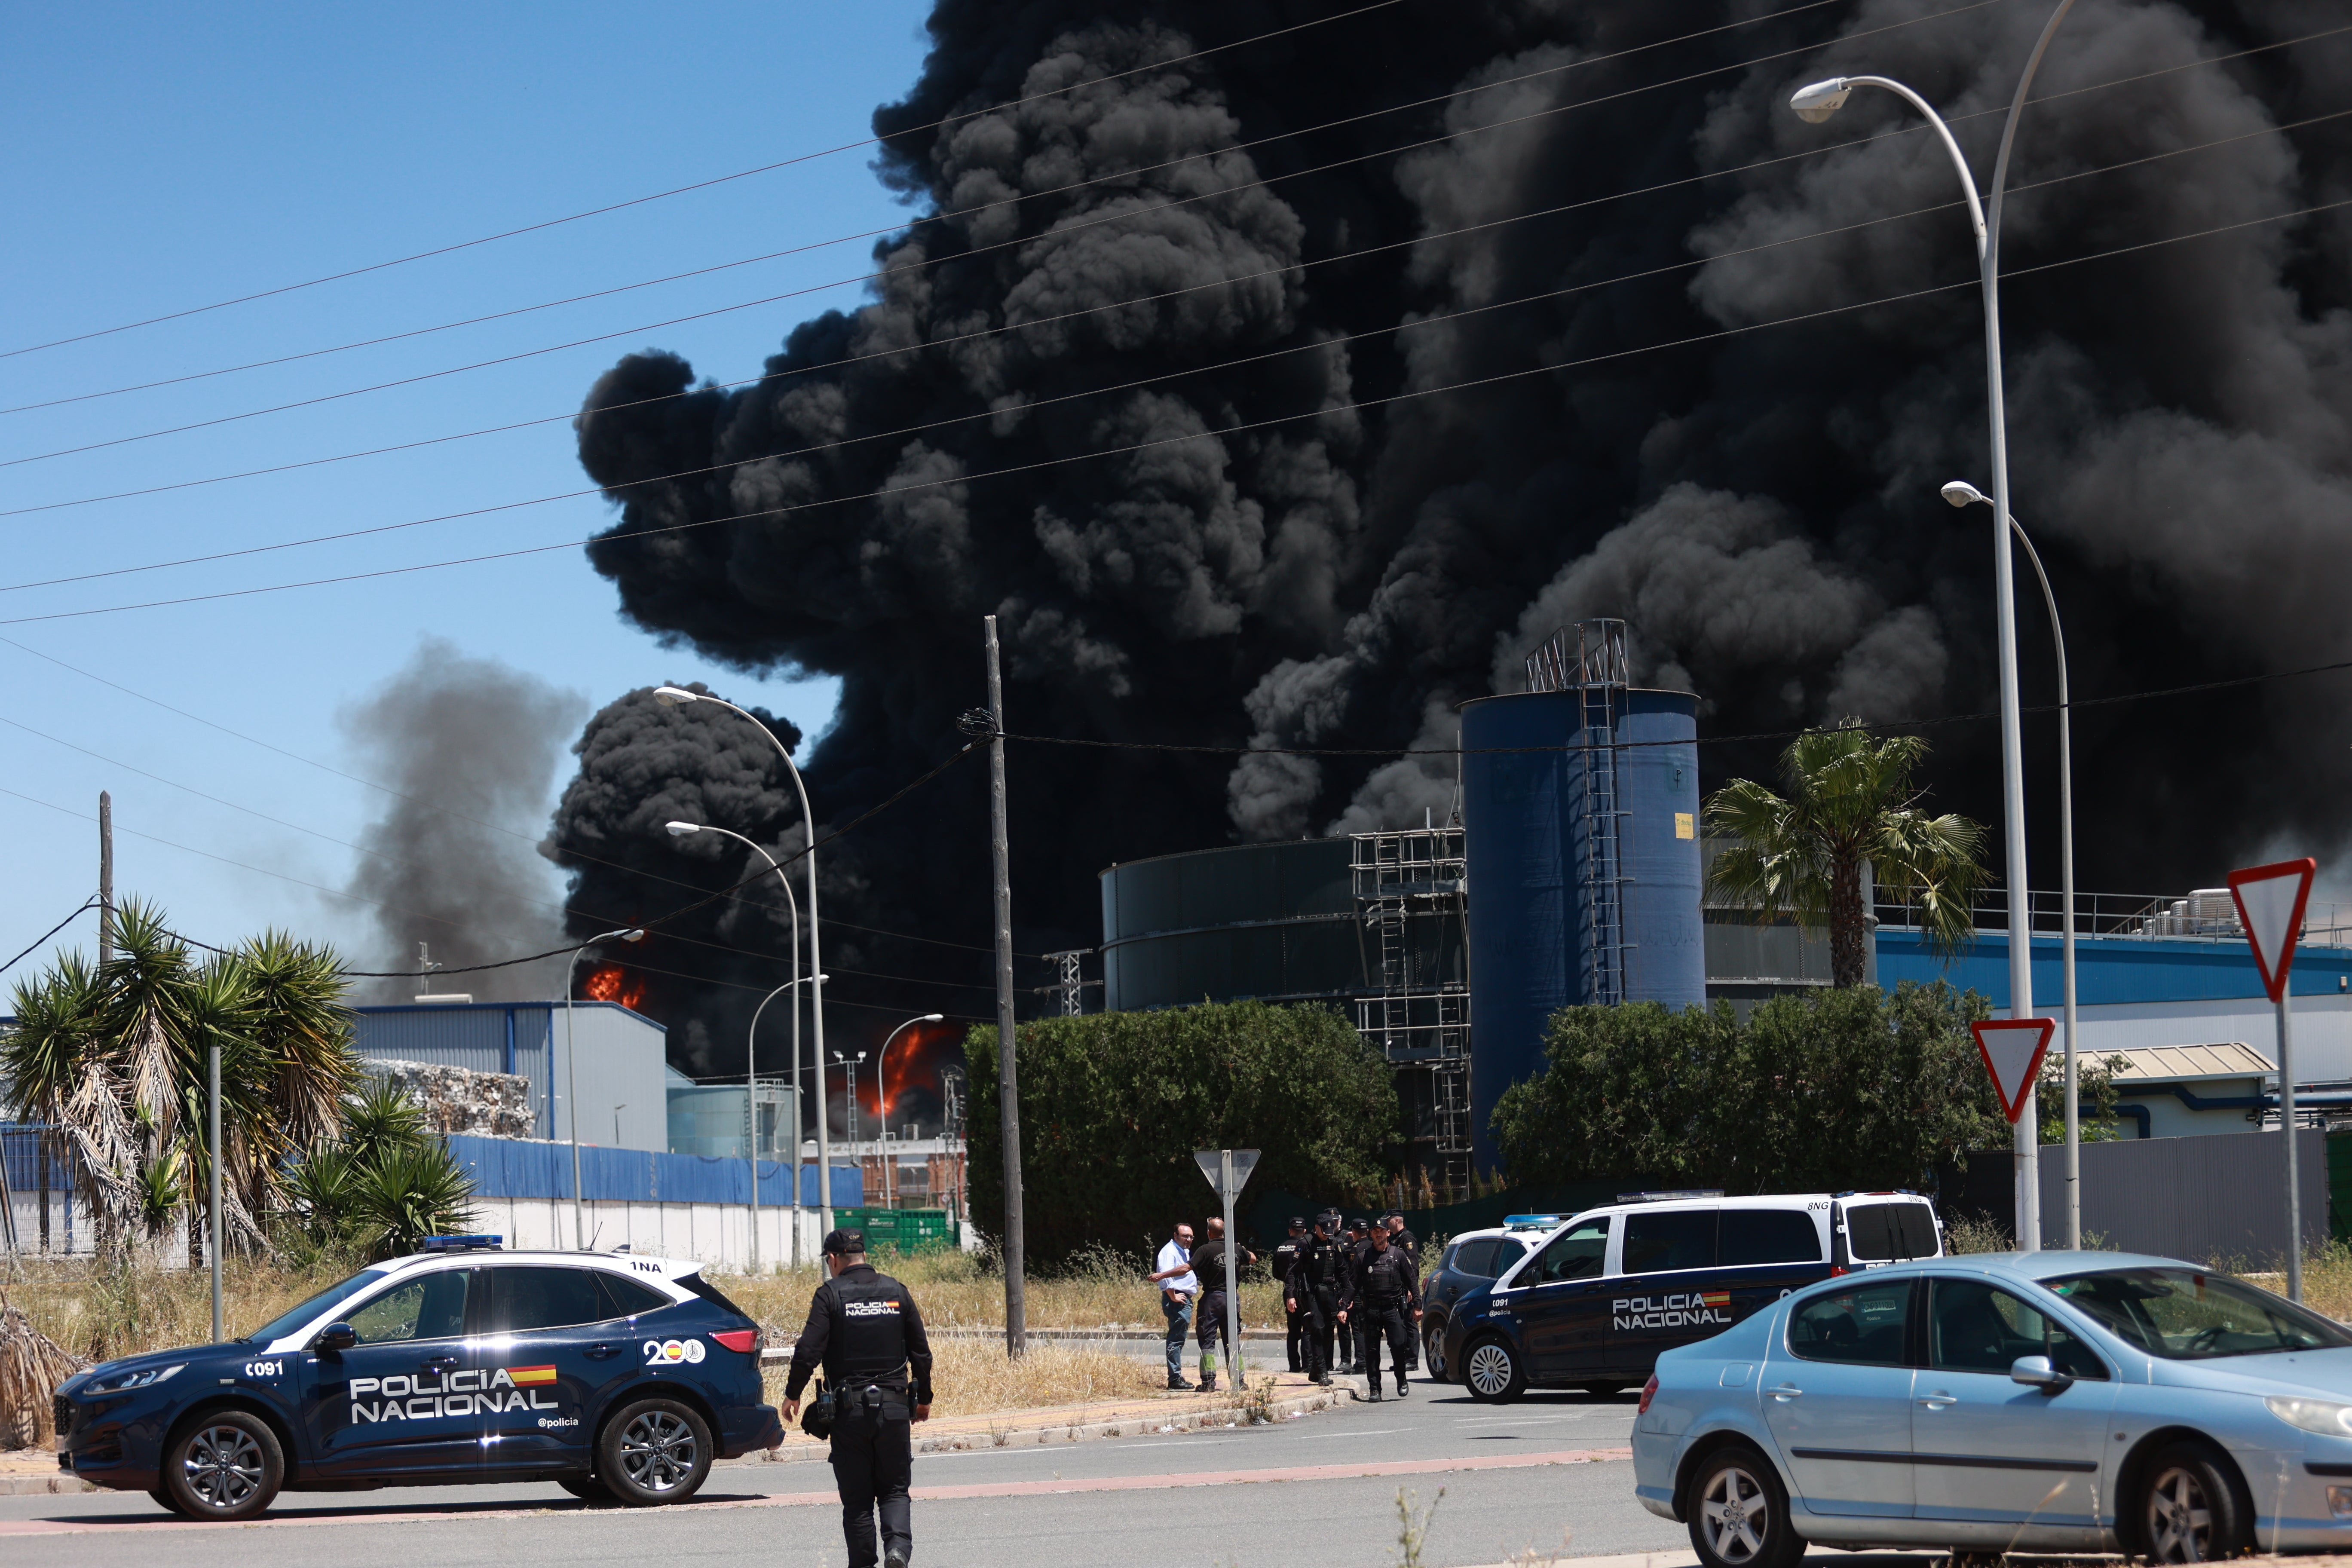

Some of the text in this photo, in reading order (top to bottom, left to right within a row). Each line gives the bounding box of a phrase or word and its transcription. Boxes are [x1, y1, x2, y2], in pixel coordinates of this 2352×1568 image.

[1807, 1202, 1828, 1210] 8NG
[630, 1261, 662, 1273] 1NA
[1495, 1298, 1508, 1307] 091
[846, 1308, 900, 1317] NACIONAL
[1614, 1308, 1731, 1330] NACIONAL
[254, 1360, 283, 1376] 091
[351, 1389, 558, 1424] NACIONAL
[538, 1418, 579, 1429] @policia
